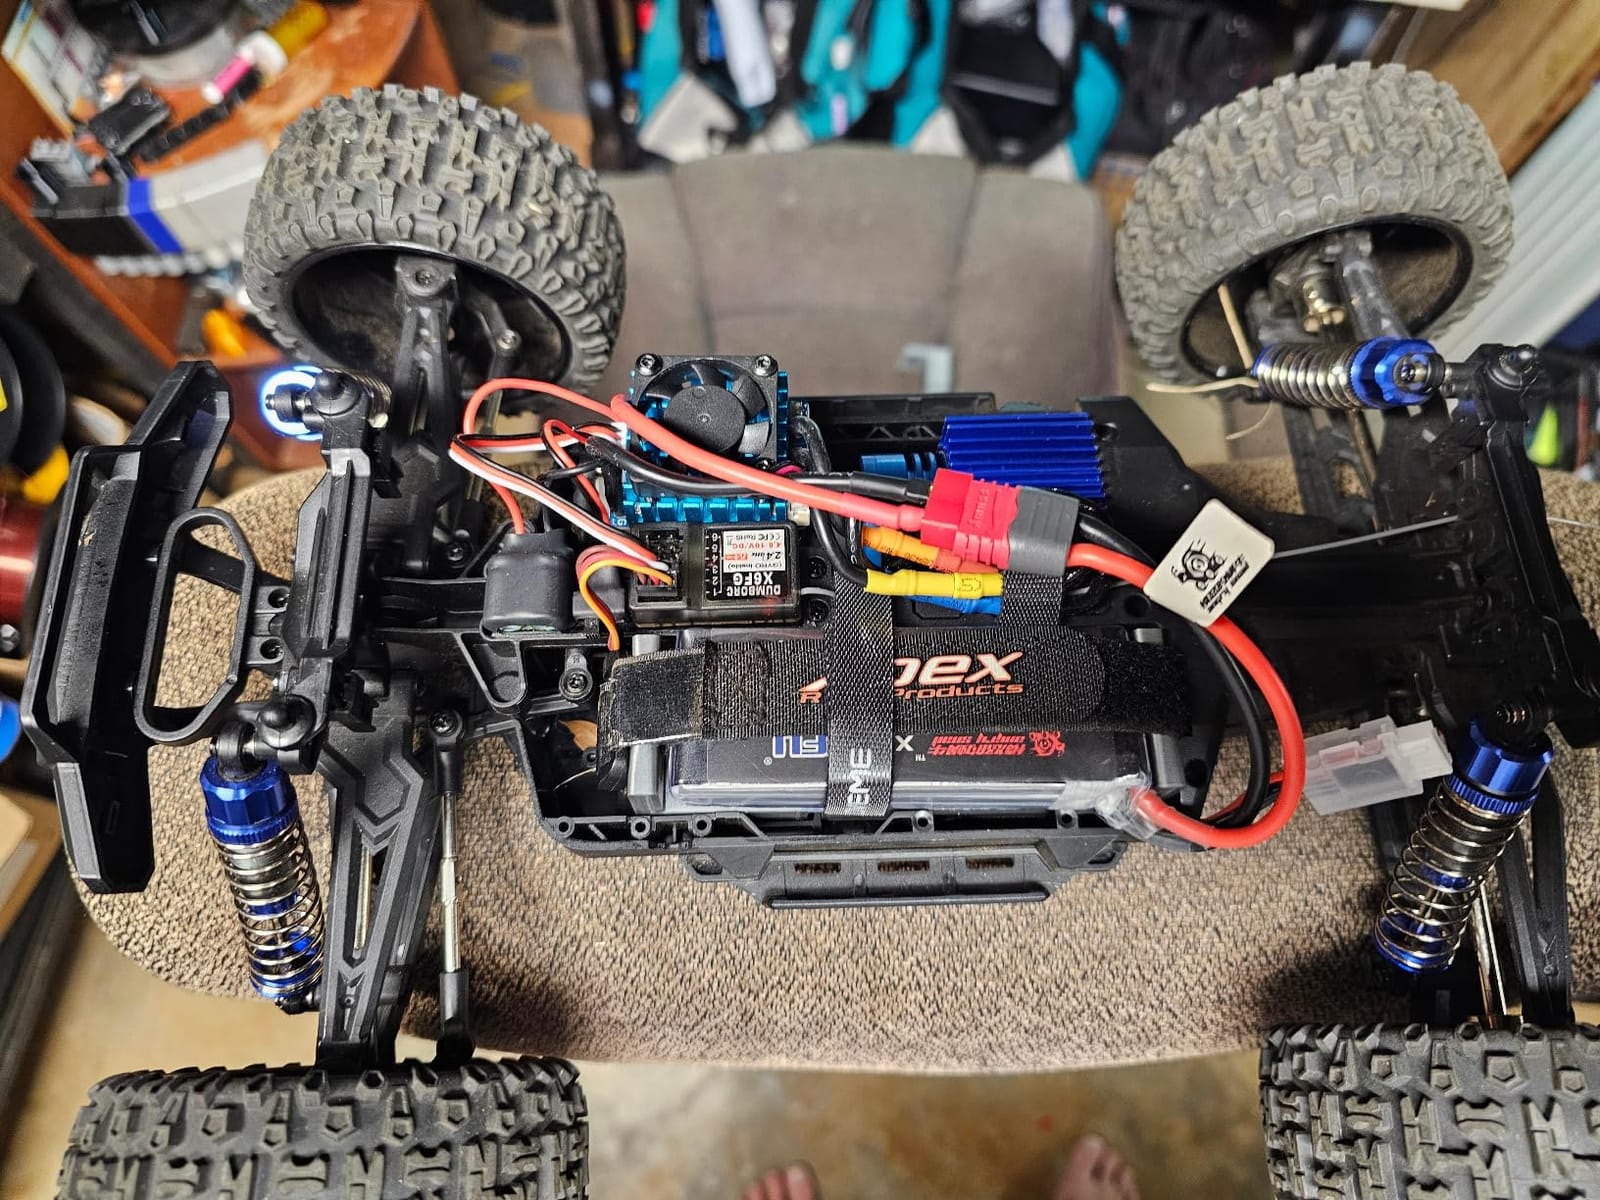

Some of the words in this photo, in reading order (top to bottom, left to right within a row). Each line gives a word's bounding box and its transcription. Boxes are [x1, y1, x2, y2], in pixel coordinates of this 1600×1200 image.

[711, 565, 718, 574] 3
[712, 576, 719, 586] 2
[732, 572, 773, 586] X6FG
[726, 584, 781, 597] DUMBORC
